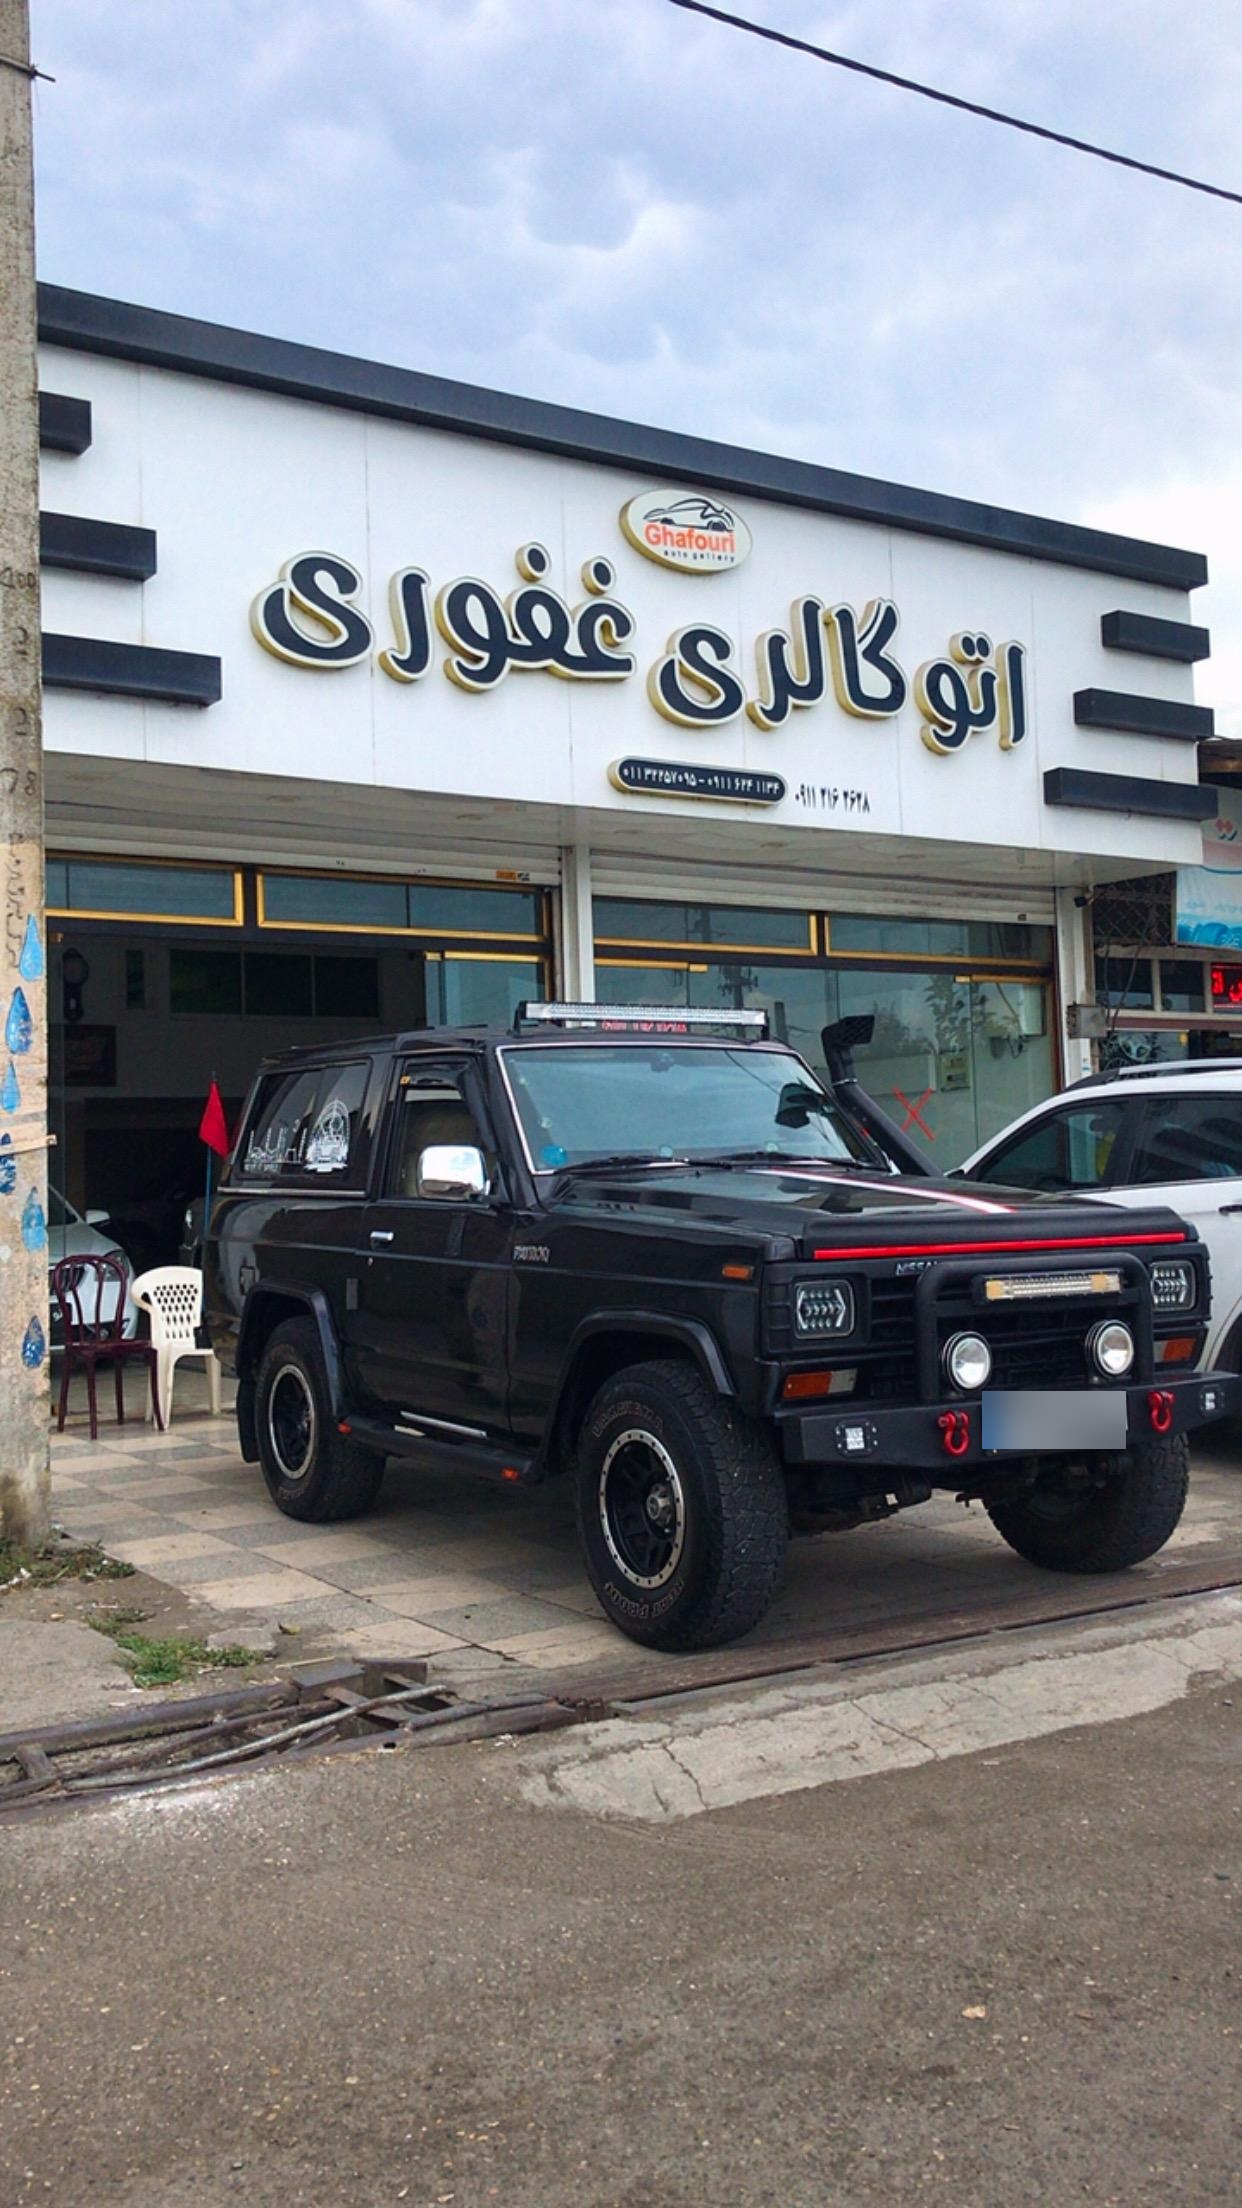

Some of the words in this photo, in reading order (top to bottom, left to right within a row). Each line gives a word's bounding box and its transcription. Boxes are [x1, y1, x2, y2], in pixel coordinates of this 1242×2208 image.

[644, 523, 736, 553] Ghafouri
[249, 541, 637, 693] غفوری
[646, 594, 906, 731] گالری
[914, 631, 1029, 755] اتو
